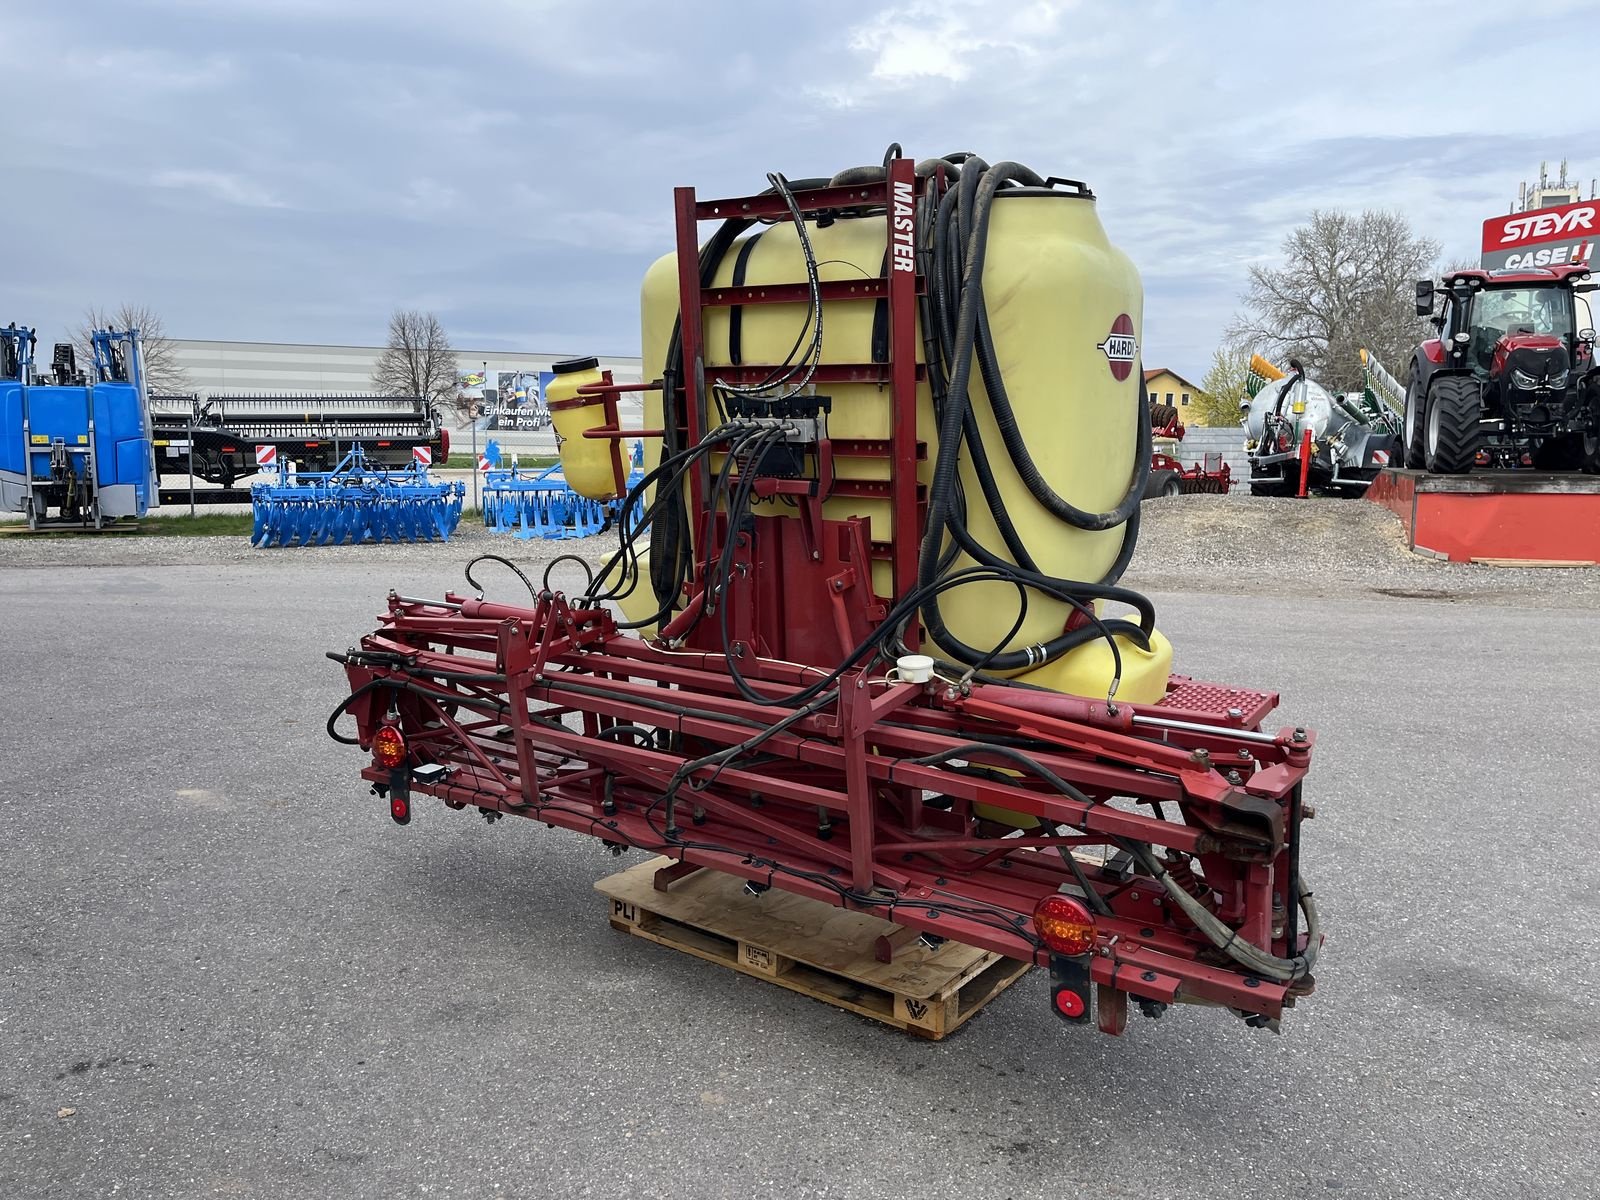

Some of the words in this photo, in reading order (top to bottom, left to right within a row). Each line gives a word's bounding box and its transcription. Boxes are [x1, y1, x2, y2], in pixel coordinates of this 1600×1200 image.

[893, 181, 914, 273] MASTER
[1500, 206, 1596, 243] STEYR
[1505, 246, 1569, 269] CASE
[1109, 339, 1135, 356] HARDI
[483, 405, 533, 416] Einkaufen
[498, 416, 514, 426] ein
[516, 417, 541, 427] Profi
